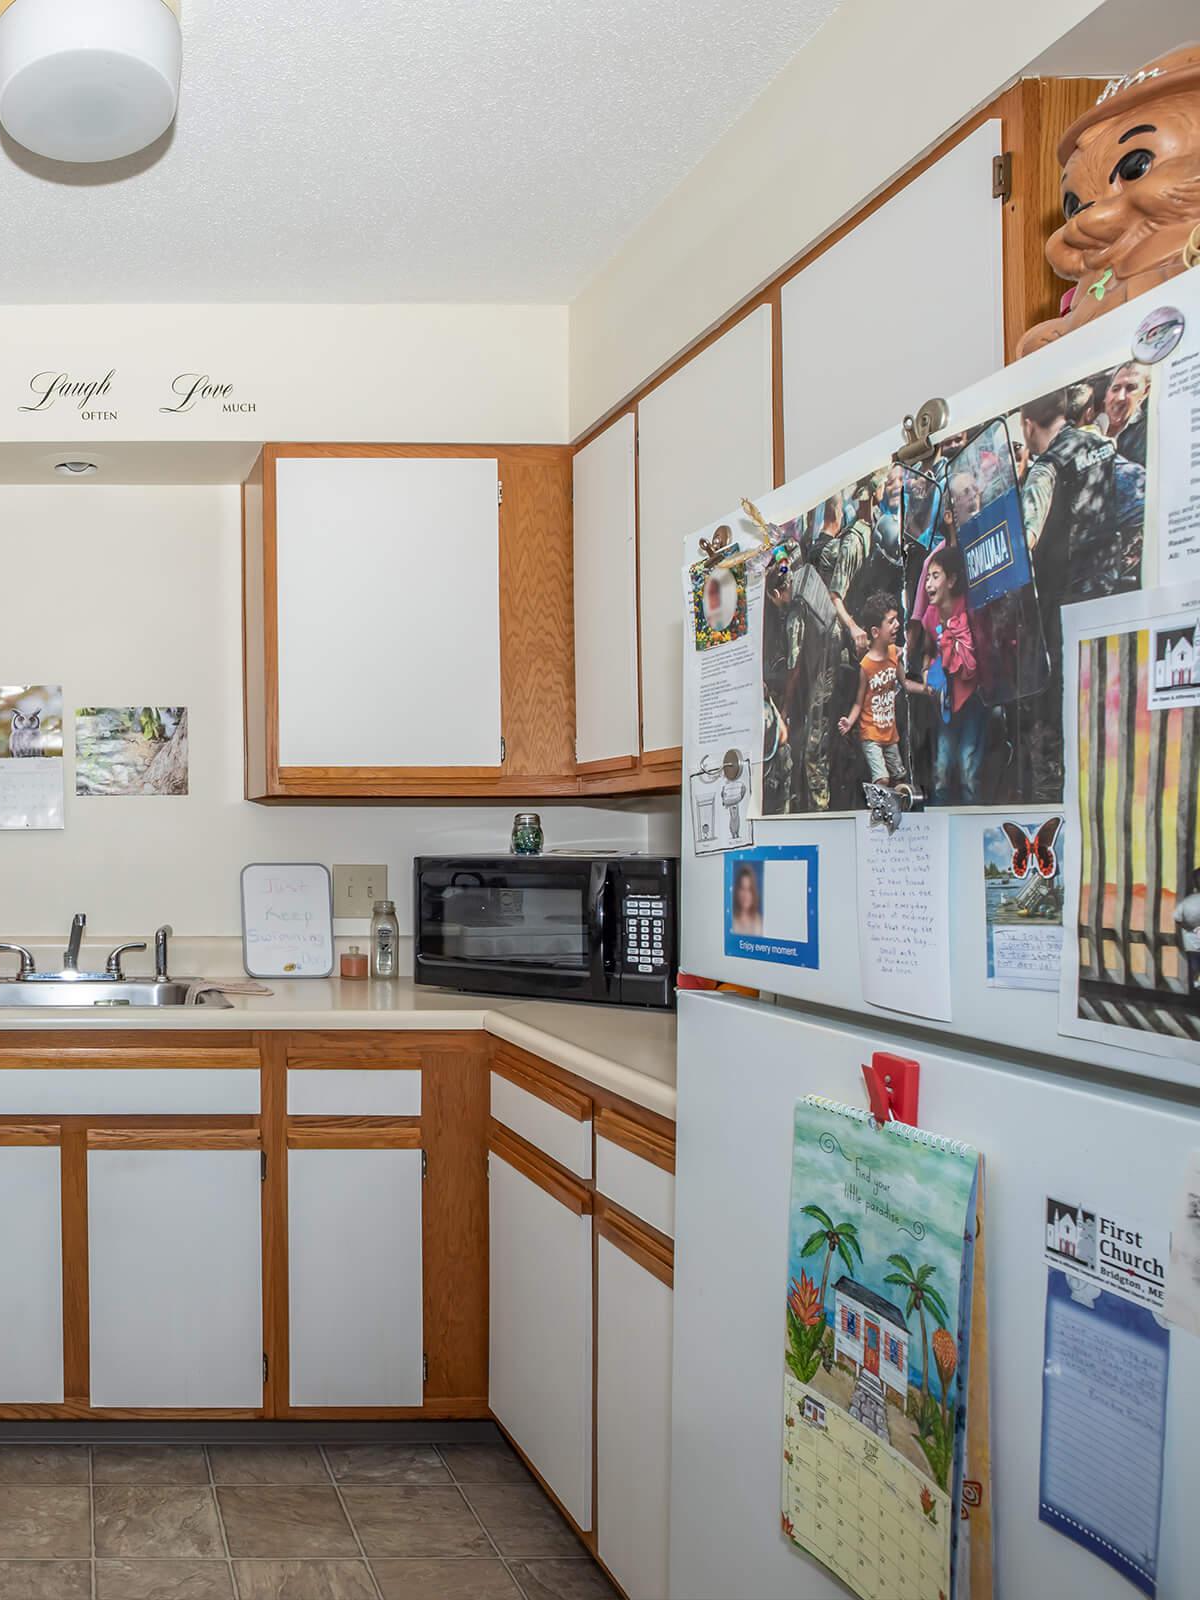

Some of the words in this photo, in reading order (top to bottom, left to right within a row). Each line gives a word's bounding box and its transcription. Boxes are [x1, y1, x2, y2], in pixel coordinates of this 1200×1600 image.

[17, 368, 116, 413] Laugh
[159, 373, 233, 413] Love
[81, 411, 118, 421] OFTEN
[222, 403, 256, 413] MUCH
[264, 903, 313, 929] Keep
[739, 939, 754, 953] Enjoy
[755, 943, 771, 955] every
[771, 946, 799, 957] moment.
[855, 1156, 871, 1184] Find
[872, 1179, 890, 1197] your
[844, 1181, 862, 1204] little
[865, 1200, 900, 1225] paradise
[1099, 1216, 1143, 1249] First
[1099, 1239, 1165, 1279] Church
[1148, 1286, 1165, 1300] ME
